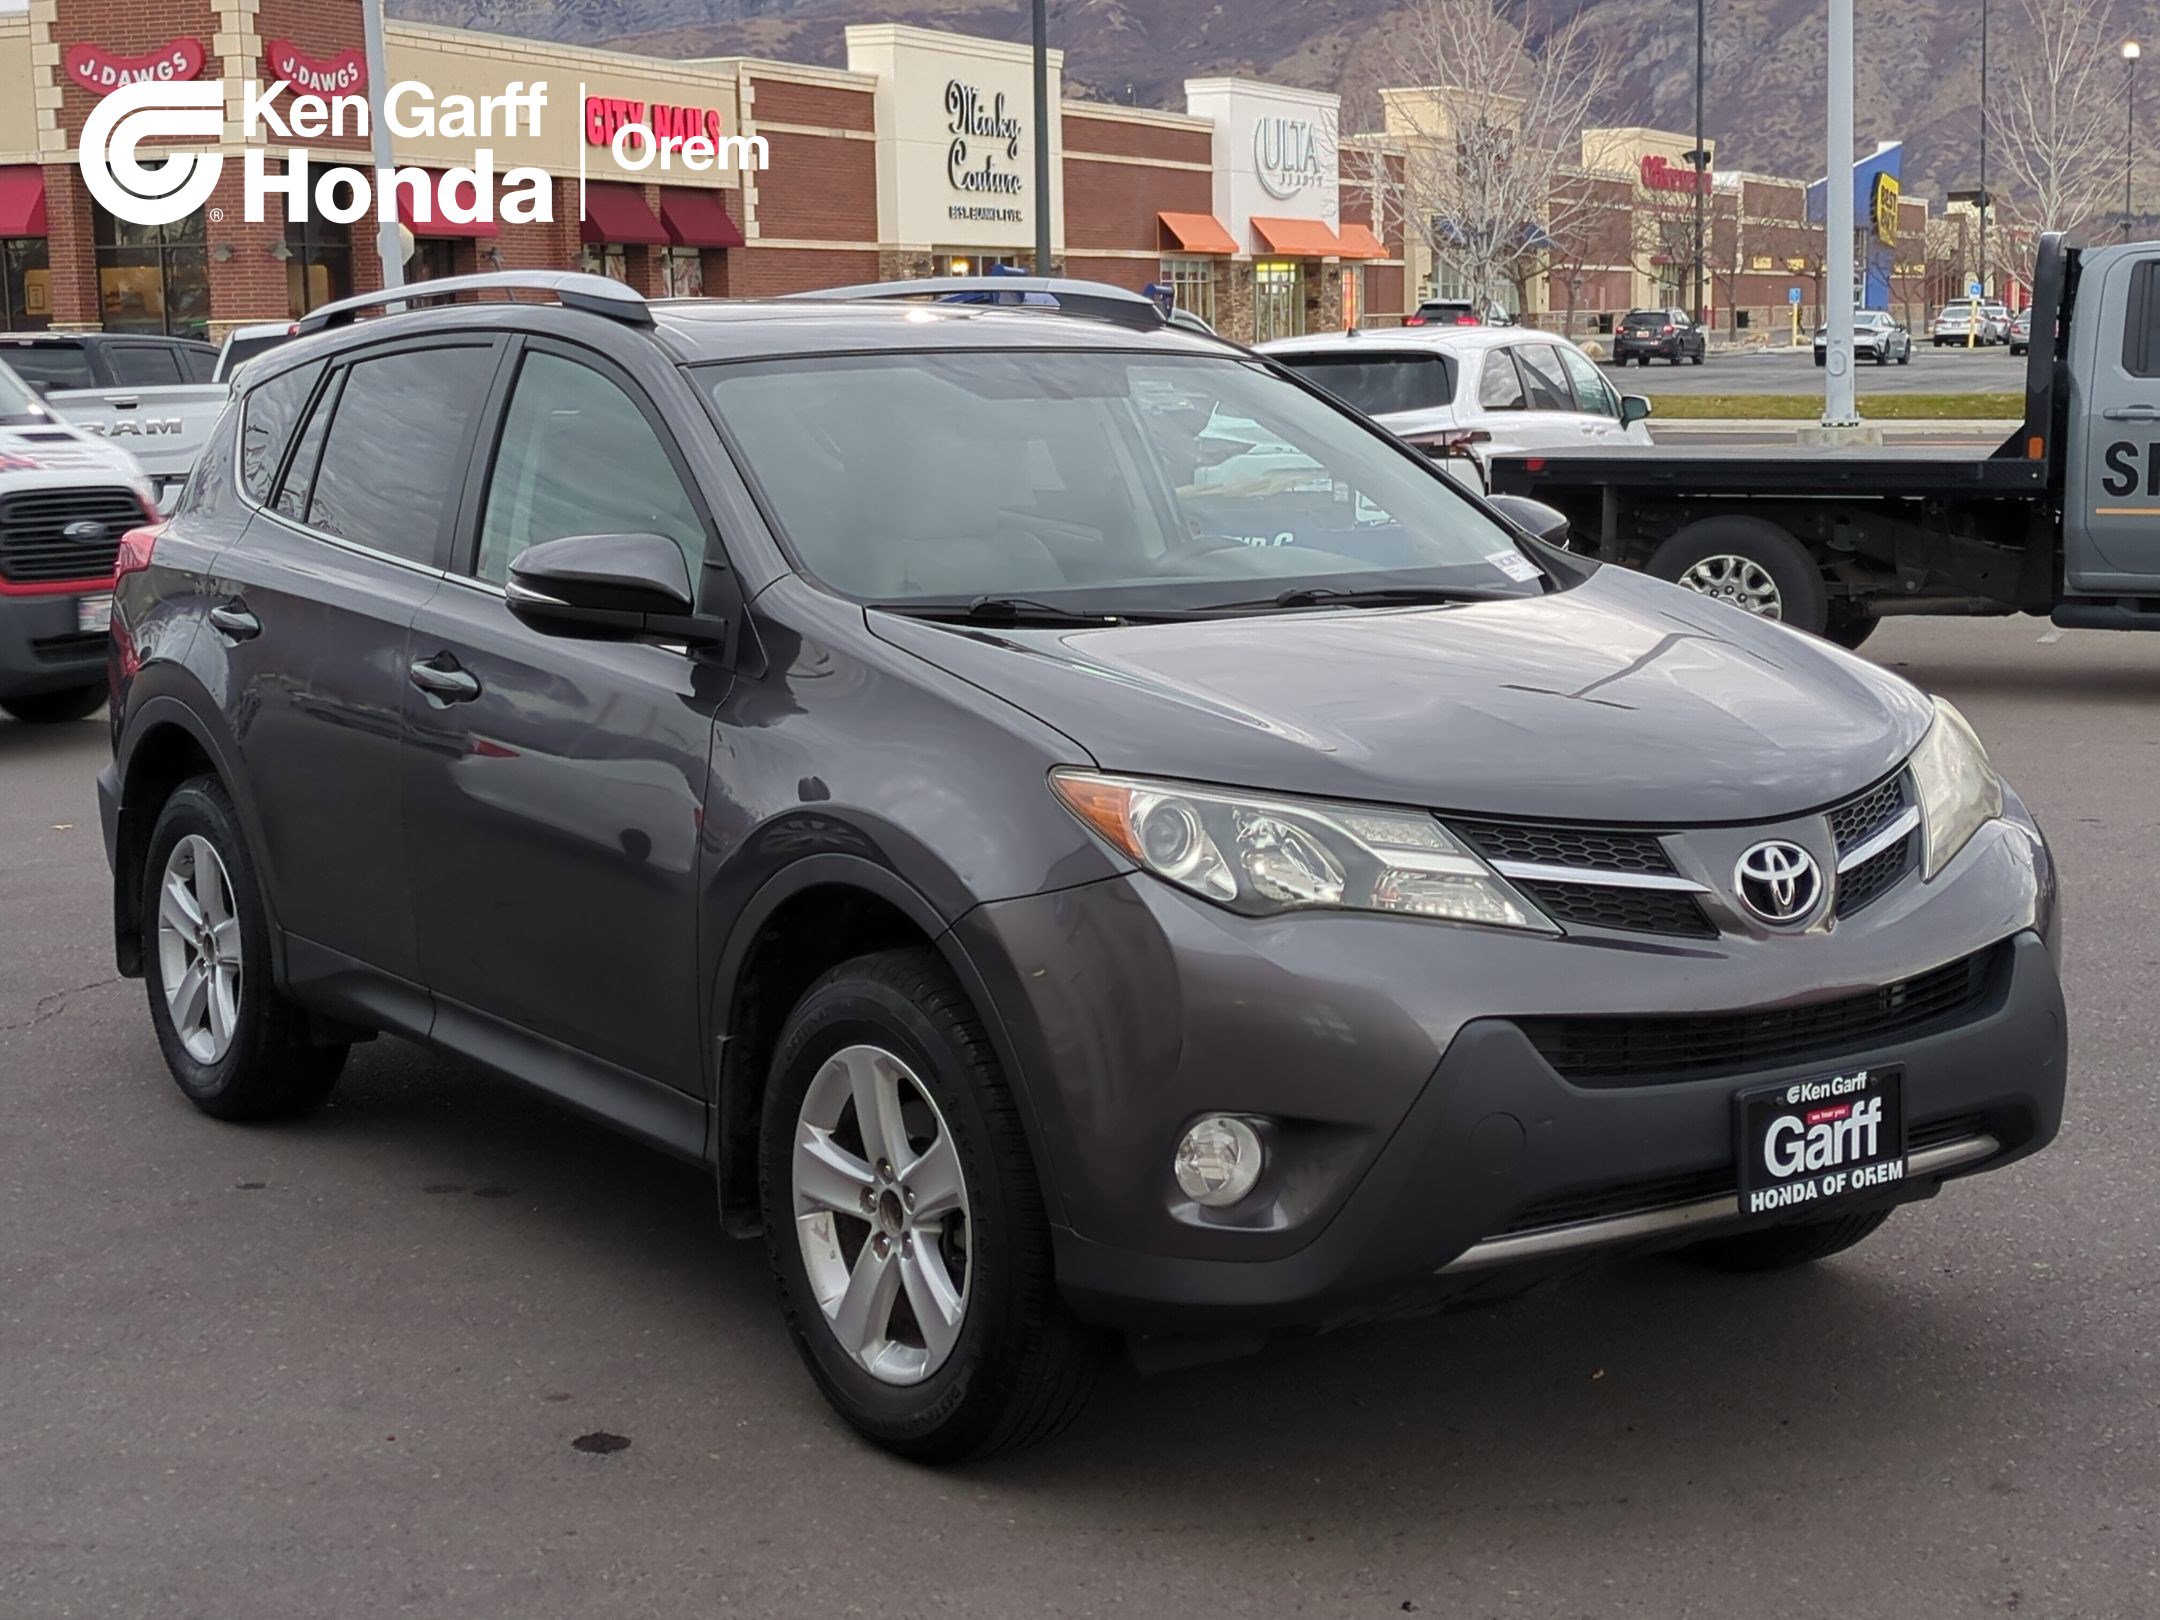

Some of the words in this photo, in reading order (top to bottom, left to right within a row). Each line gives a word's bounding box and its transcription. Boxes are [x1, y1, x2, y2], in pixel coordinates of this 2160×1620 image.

[79, 51, 188, 85] J.DAWGS
[282, 57, 360, 92] J.DAWGS
[586, 97, 645, 150] CITY
[944, 79, 1022, 160] Minky
[947, 137, 1022, 195] Couture
[1262, 117, 1321, 175] ULTA
[1880, 185, 1898, 213] BEST
[76, 418, 183, 437] RAM
[1801, 1082, 1831, 1103] Ken
[1831, 1071, 1868, 1094] Garff
[1764, 1096, 1882, 1178] Garff
[1750, 1183, 1818, 1212] HONDA
[1822, 1173, 1847, 1197] OF
[1851, 1160, 1903, 1190] OREM
